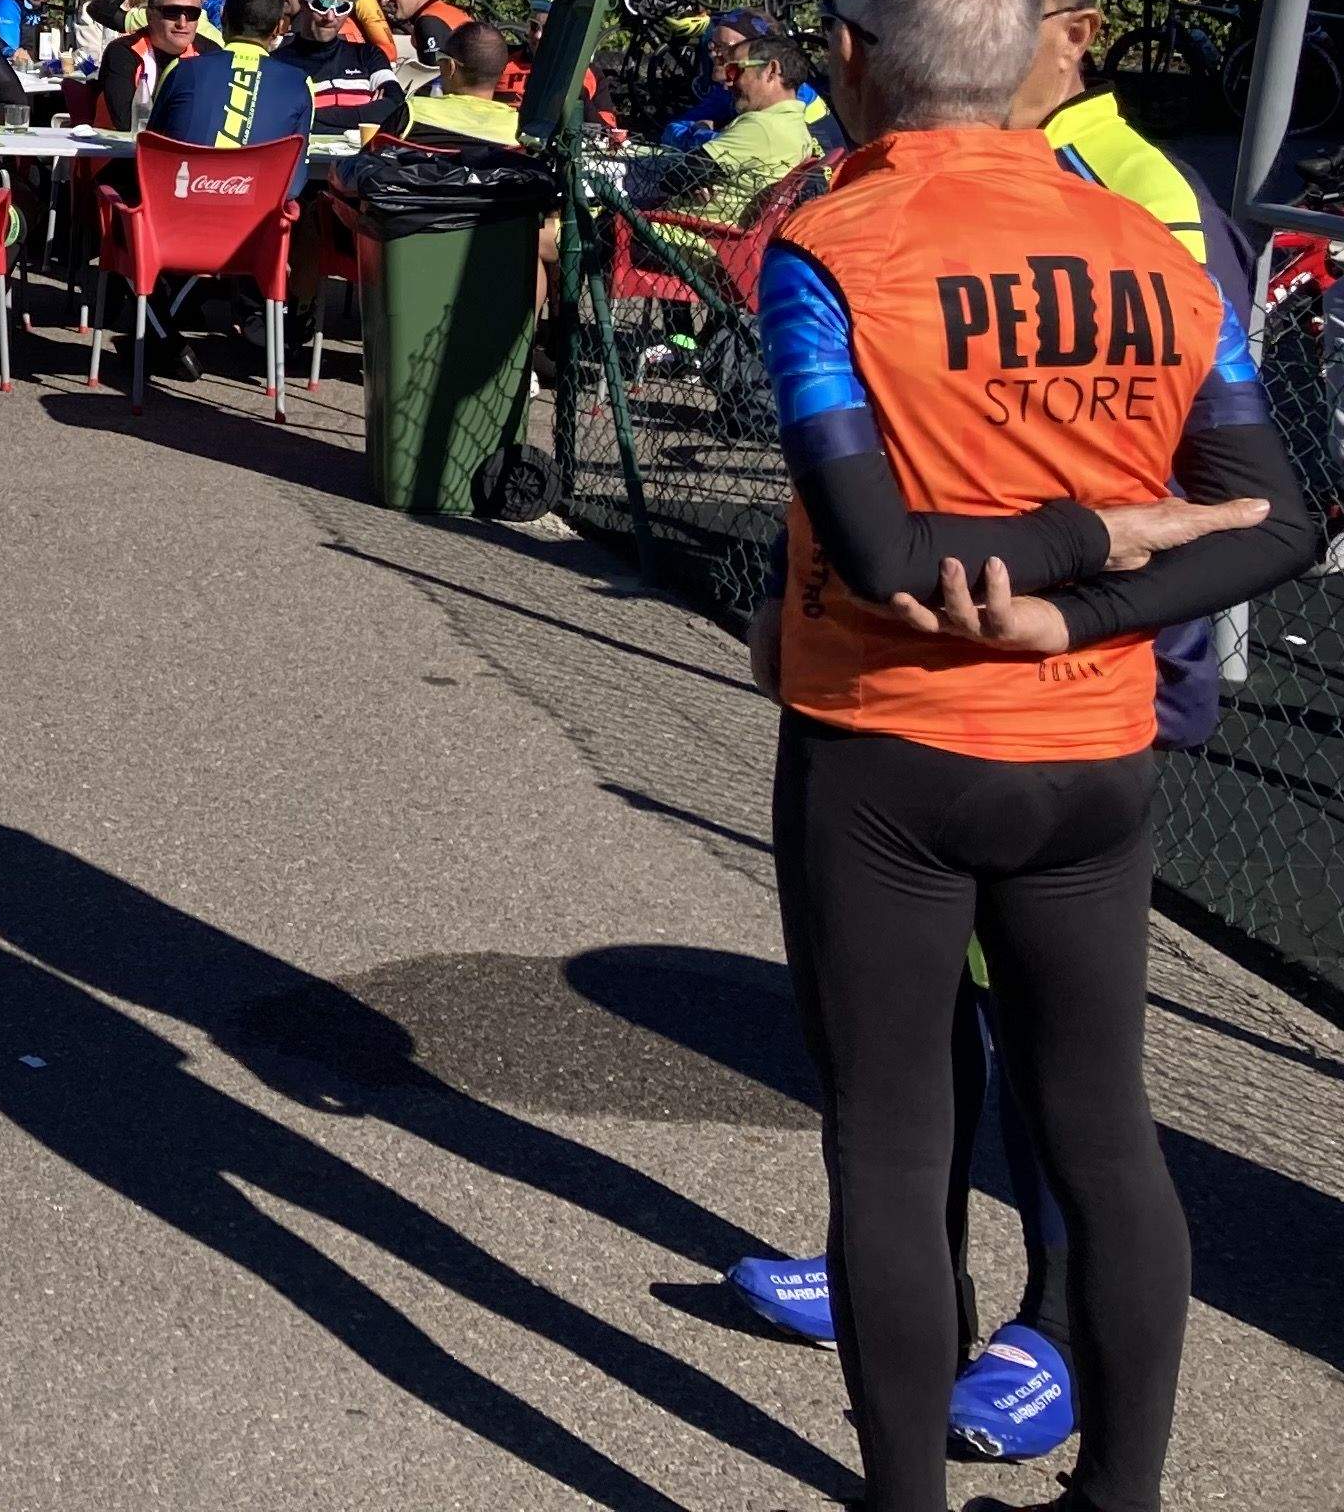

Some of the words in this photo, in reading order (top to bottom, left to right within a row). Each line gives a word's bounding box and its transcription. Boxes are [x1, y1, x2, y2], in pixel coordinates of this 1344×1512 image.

[936, 255, 1182, 371] PEDAL
[986, 376, 1158, 426] STORE
[770, 1274, 803, 1285] CLUB
[775, 1287, 829, 1301] BARBAS
